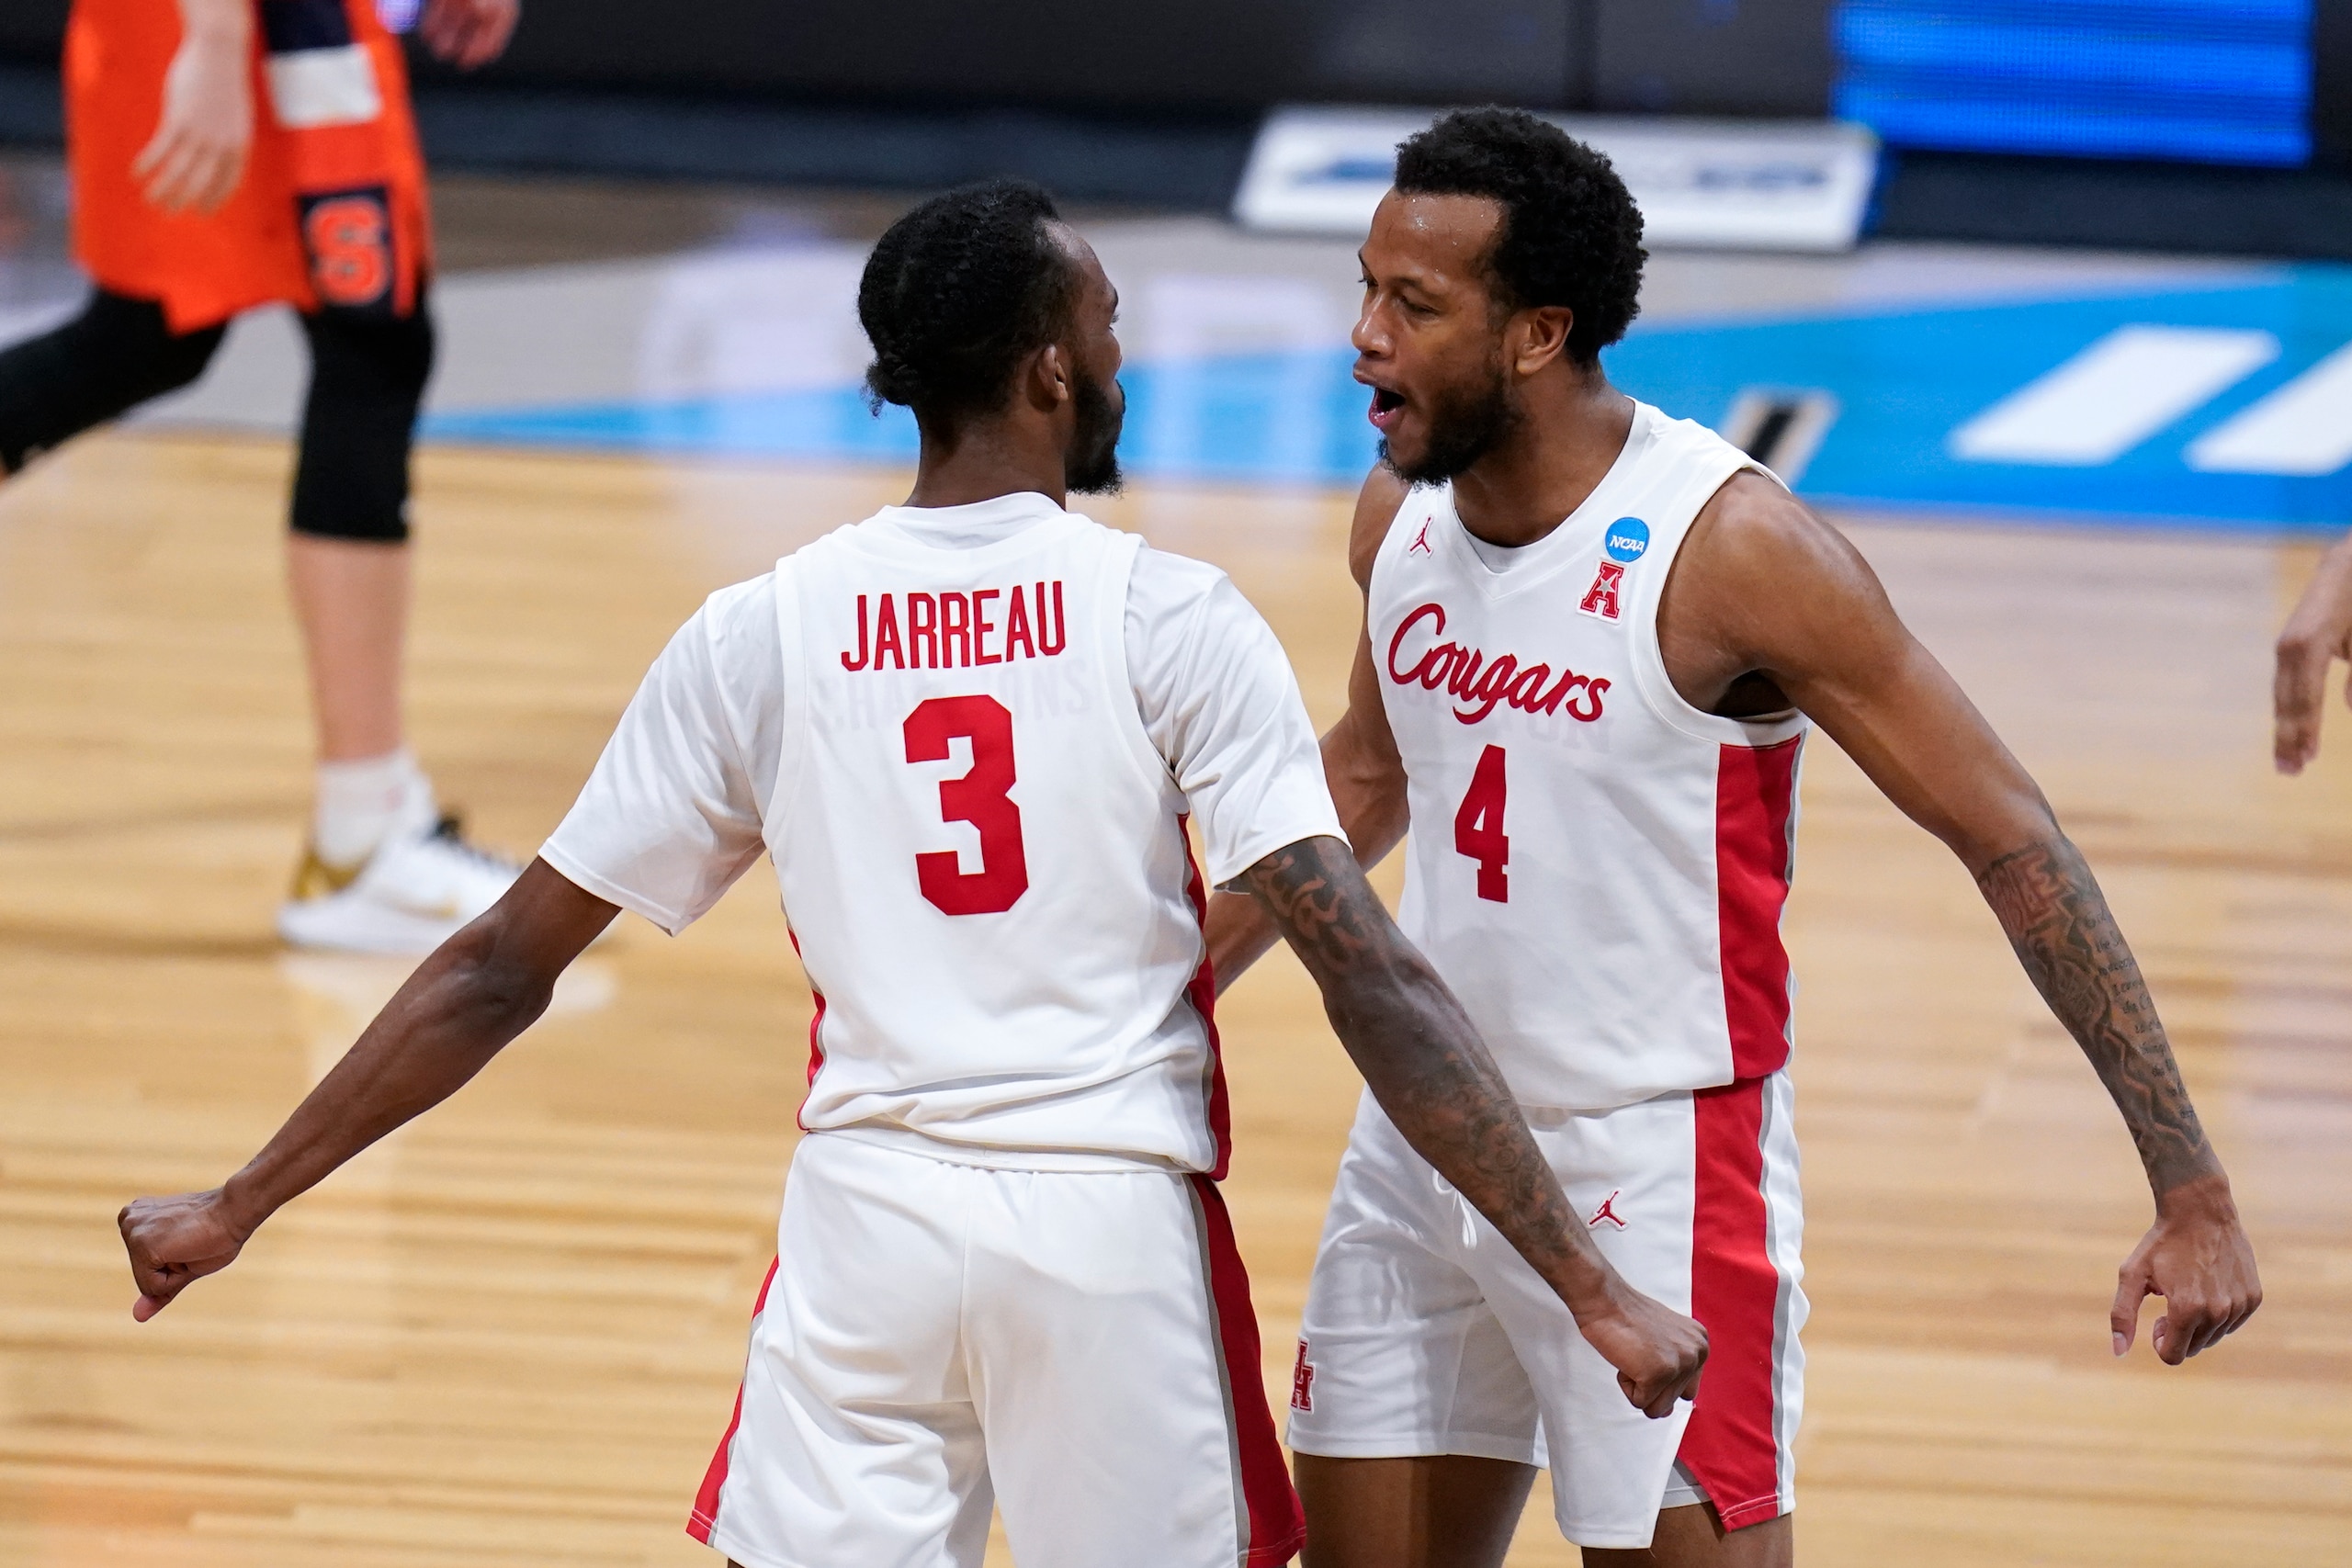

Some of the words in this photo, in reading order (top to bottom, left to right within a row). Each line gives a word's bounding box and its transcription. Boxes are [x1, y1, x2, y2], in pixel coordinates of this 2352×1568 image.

[1609, 535, 1645, 553] NCAA
[841, 580, 1067, 672] JARREAU
[1387, 603, 1611, 726] Cougars
[902, 694, 1029, 917] 3
[1454, 743, 1510, 904] 4
